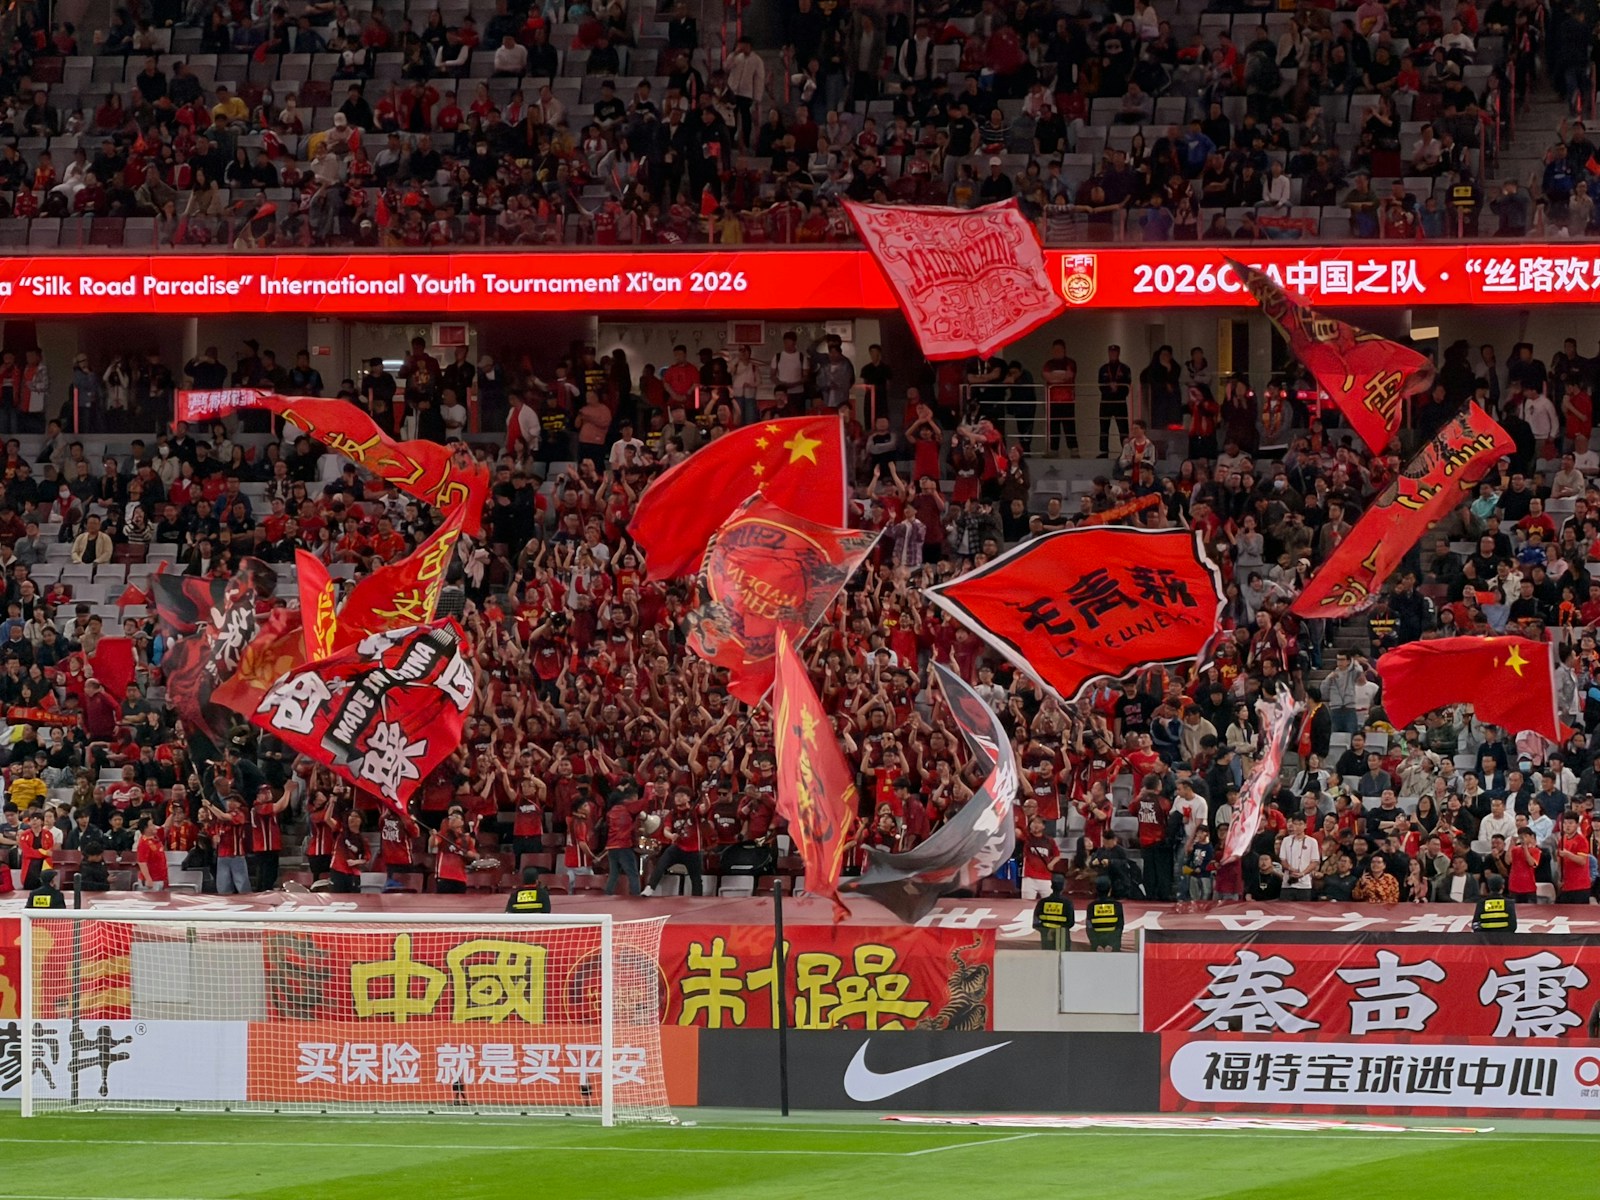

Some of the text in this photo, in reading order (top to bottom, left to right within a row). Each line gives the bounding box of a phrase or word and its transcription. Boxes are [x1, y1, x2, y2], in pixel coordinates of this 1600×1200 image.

[19, 276, 72, 296] “Silk
[79, 275, 136, 296] Road
[143, 275, 253, 296] Paradise”
[260, 274, 405, 295] International
[411, 274, 475, 294] Youth
[482, 273, 621, 294] Tournament
[625, 272, 682, 293] Xi'an
[690, 271, 747, 292] 2026
[1065, 257, 1093, 268] CFA
[332, 689, 375, 744] MADE
[362, 670, 391, 695] IN
[385, 641, 437, 681] CHINA
[350, 933, 548, 1025] 中國
[296, 1041, 647, 1086] 买保险 就是买平安
[1203, 1051, 1559, 1097] 福特宝球迷中心
